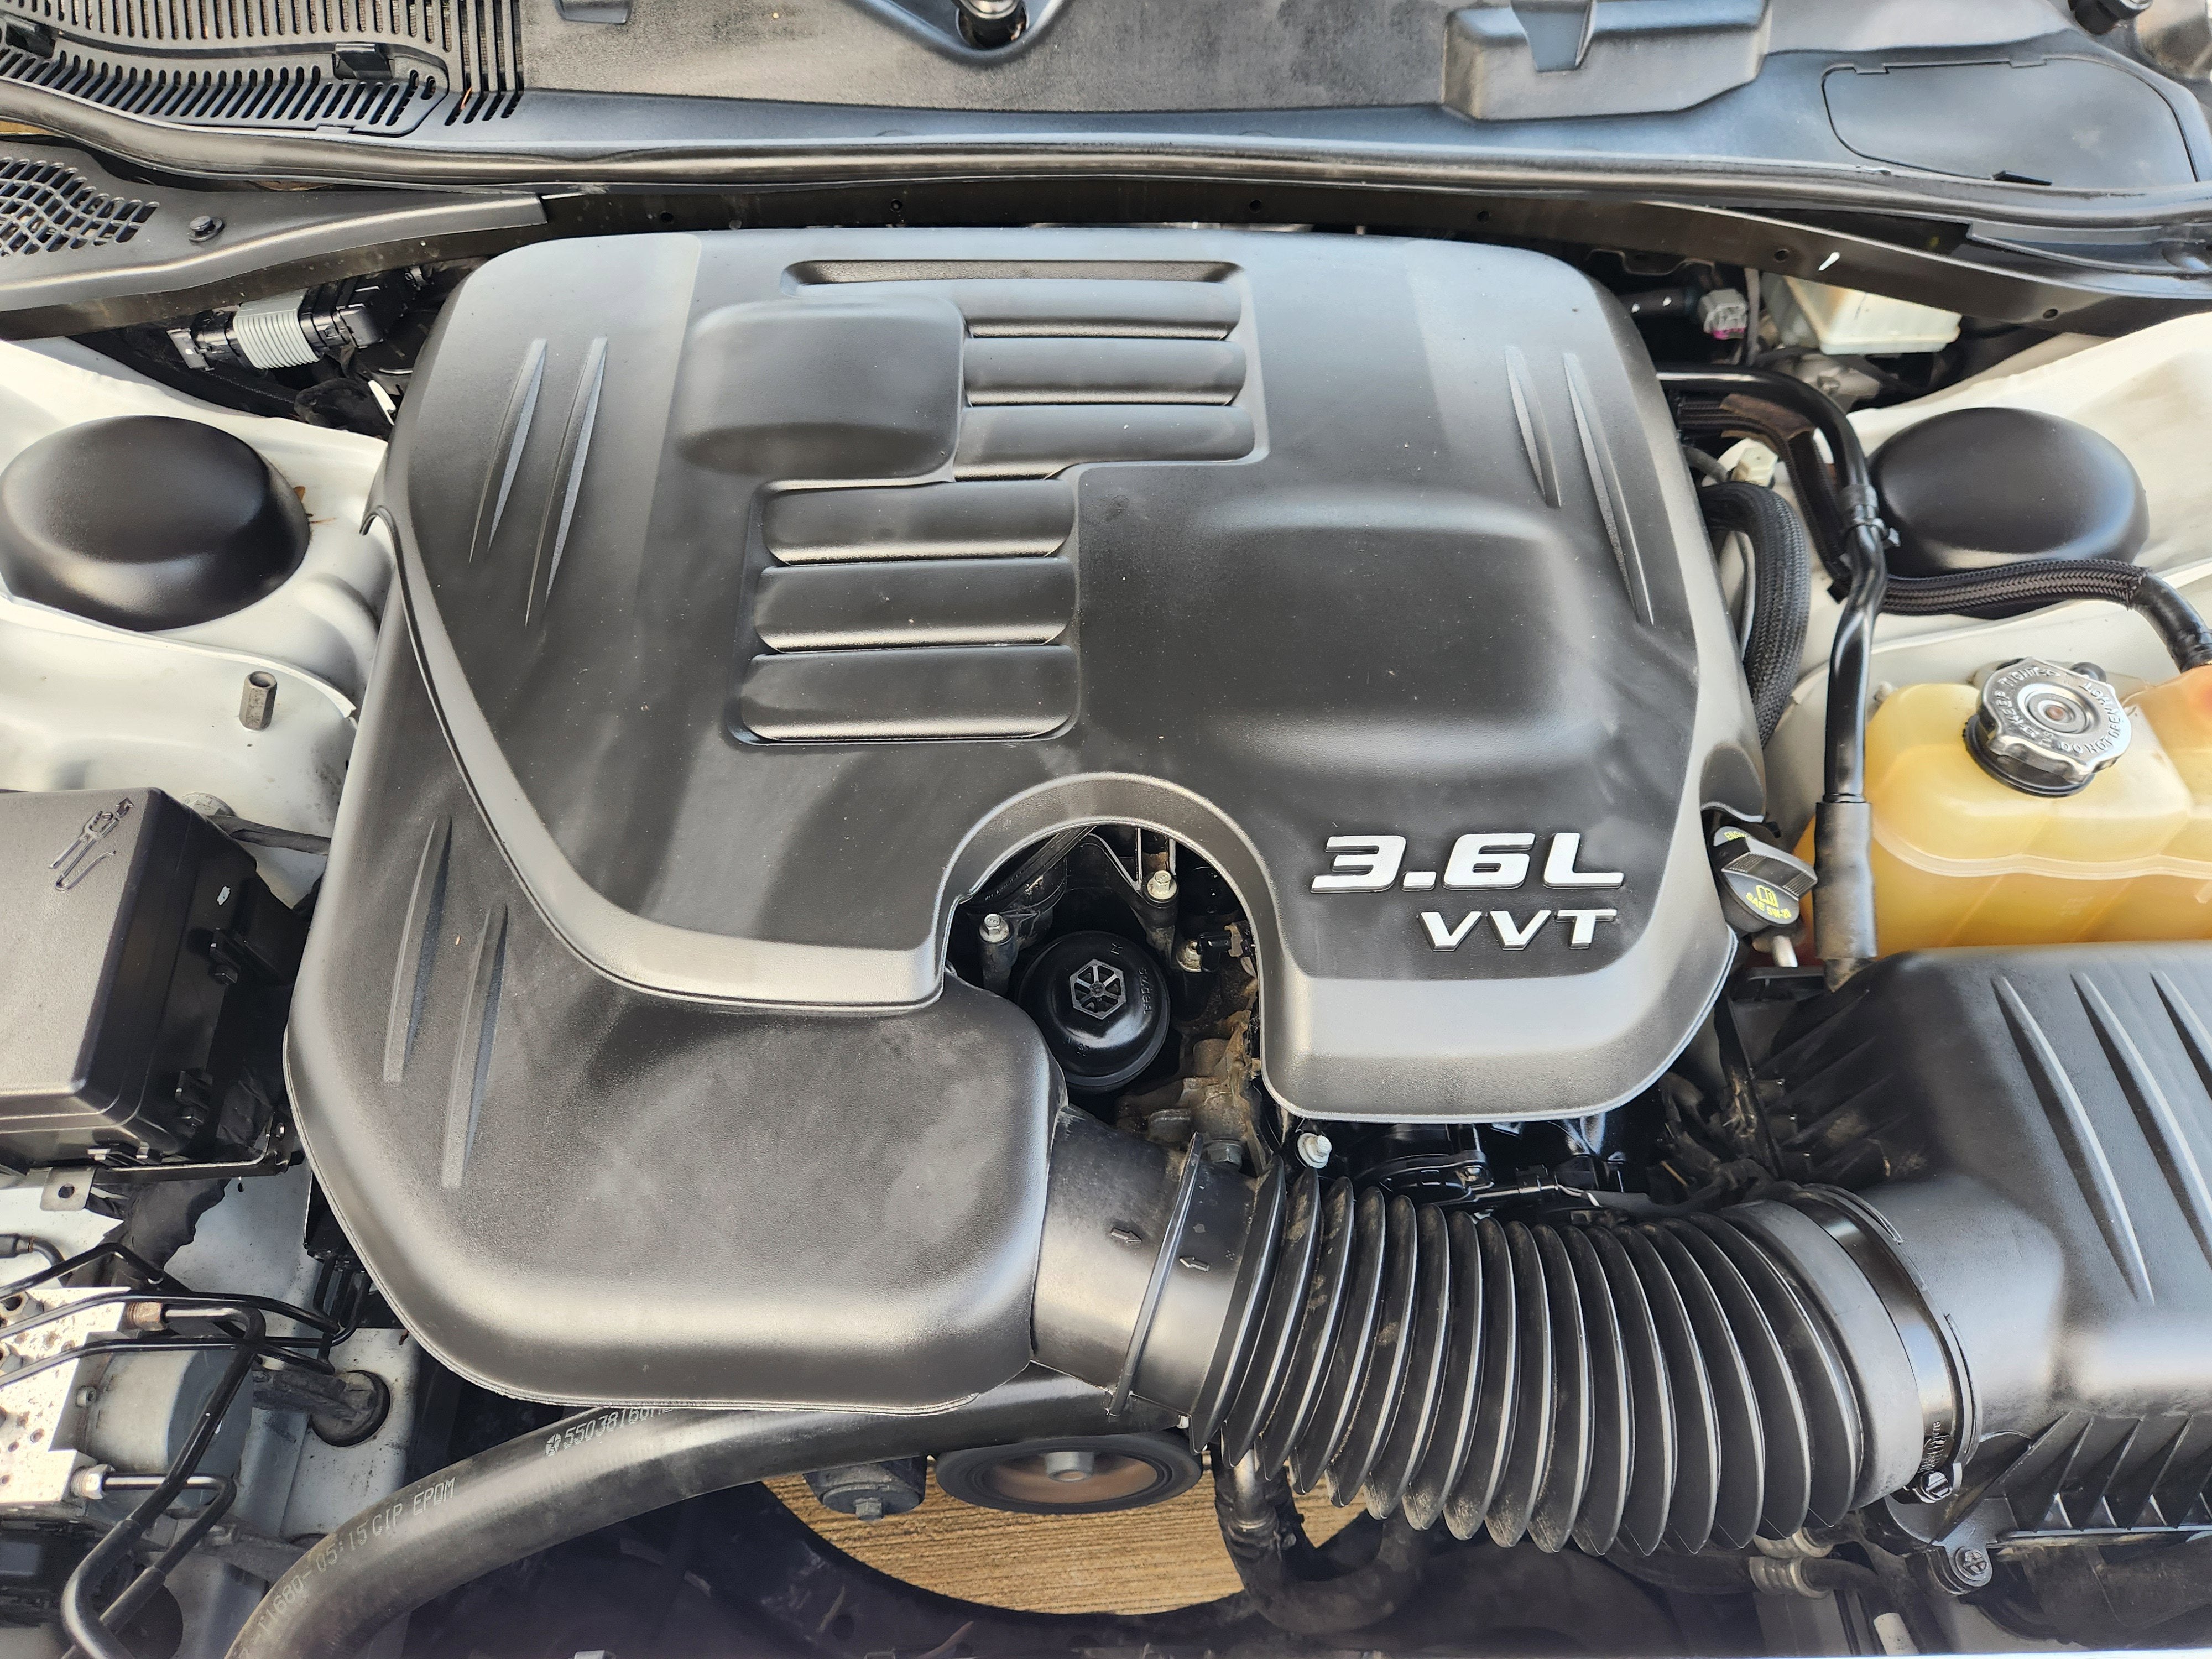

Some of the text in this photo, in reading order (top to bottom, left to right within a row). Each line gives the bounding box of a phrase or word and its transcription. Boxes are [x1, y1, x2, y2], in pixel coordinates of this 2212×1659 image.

[1994, 667, 2039, 724] KEEP TIGHT
[2059, 742, 2084, 754] DO
[2084, 735, 2114, 754] NOT
[2104, 707, 2122, 739] OPEN
[1310, 832, 1625, 892] 3.6L
[1746, 892, 1792, 919] SAE 5W-20
[1417, 909, 1618, 951] VVT
[563, 1408, 672, 1449] 55038160
